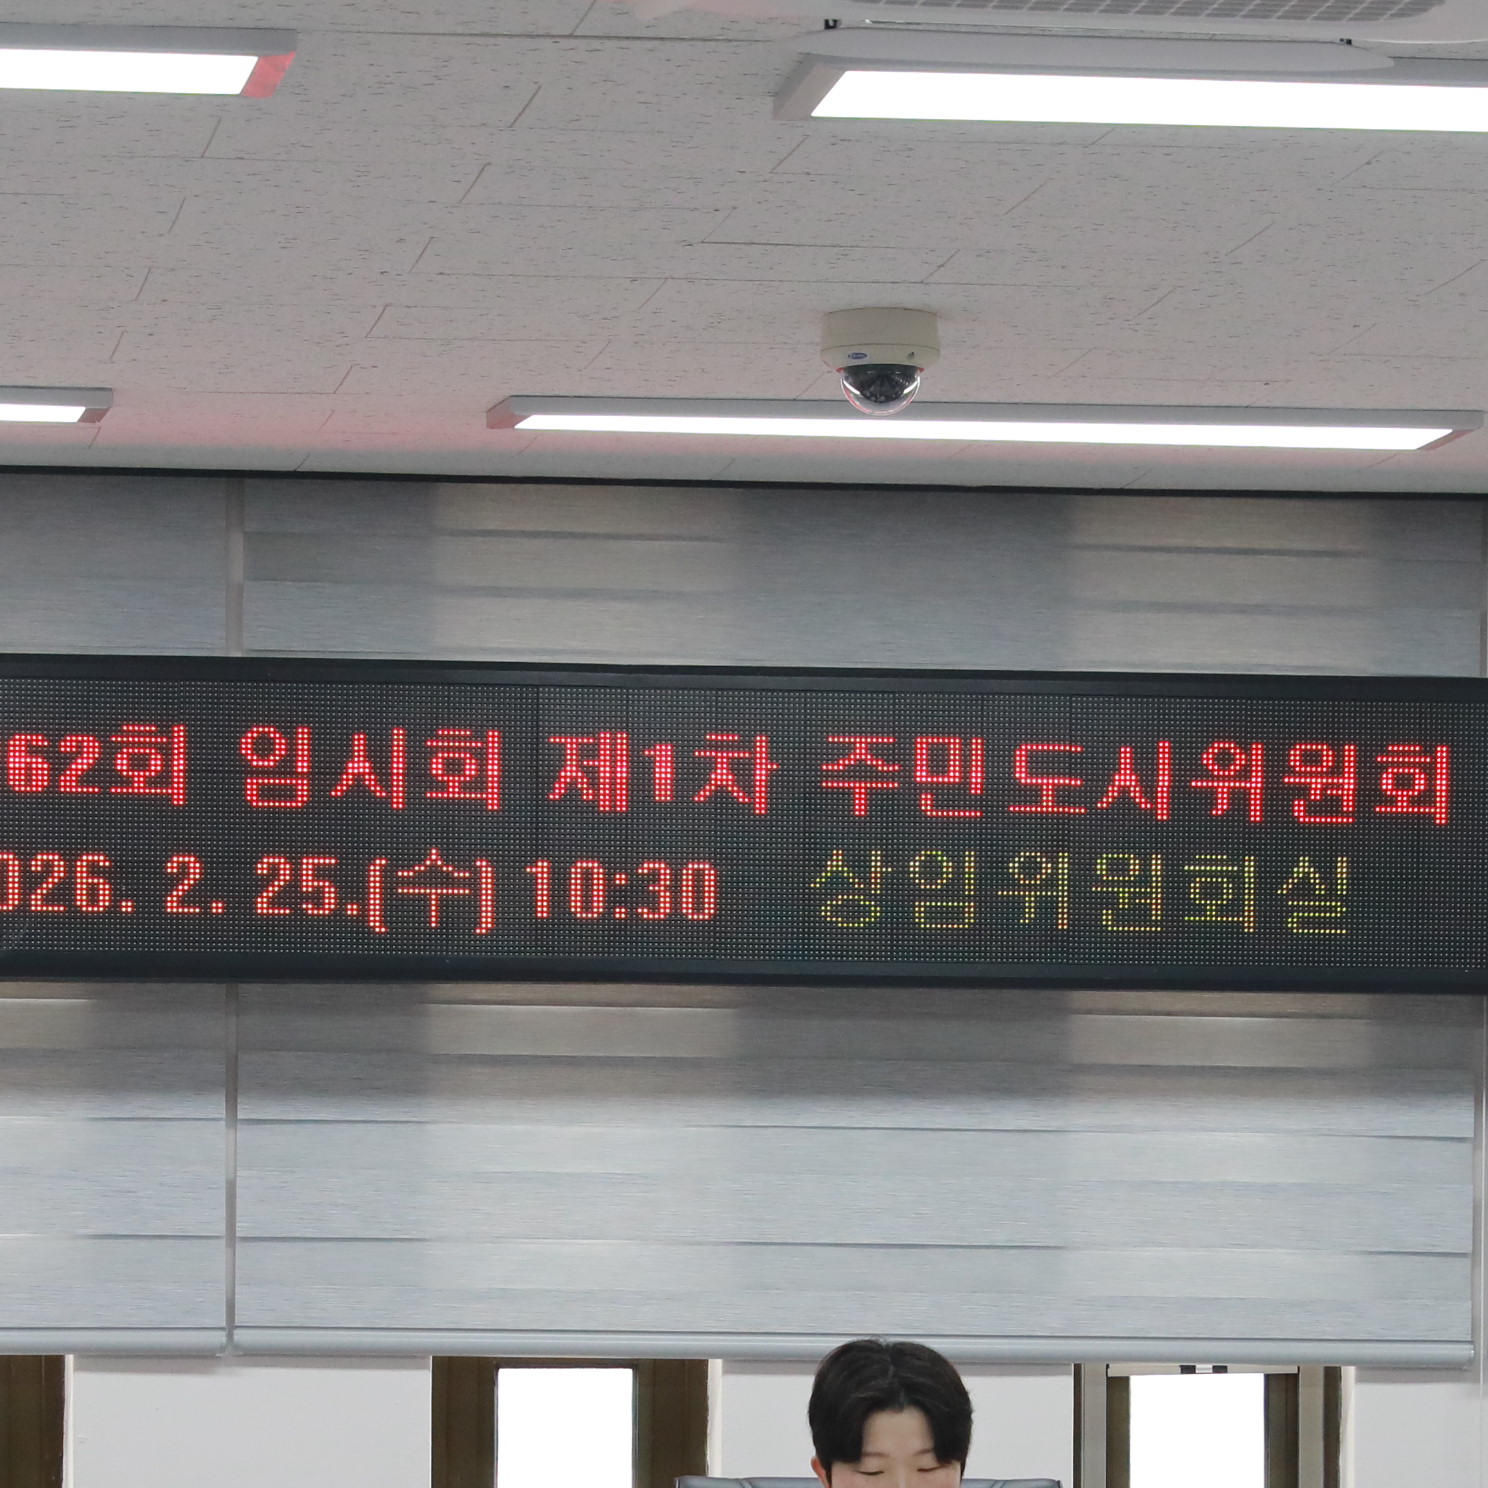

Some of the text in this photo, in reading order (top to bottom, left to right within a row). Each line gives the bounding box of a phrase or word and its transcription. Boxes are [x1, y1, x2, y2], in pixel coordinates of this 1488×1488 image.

[239, 726, 502, 811] 임시회
[548, 731, 780, 815] 제1차
[821, 735, 1451, 825] 주민도시위원회
[166, 854, 224, 914] 2.
[256, 847, 496, 935] 25.(수)
[525, 859, 718, 920] 10:30
[810, 850, 1348, 934] 상임위원회실
